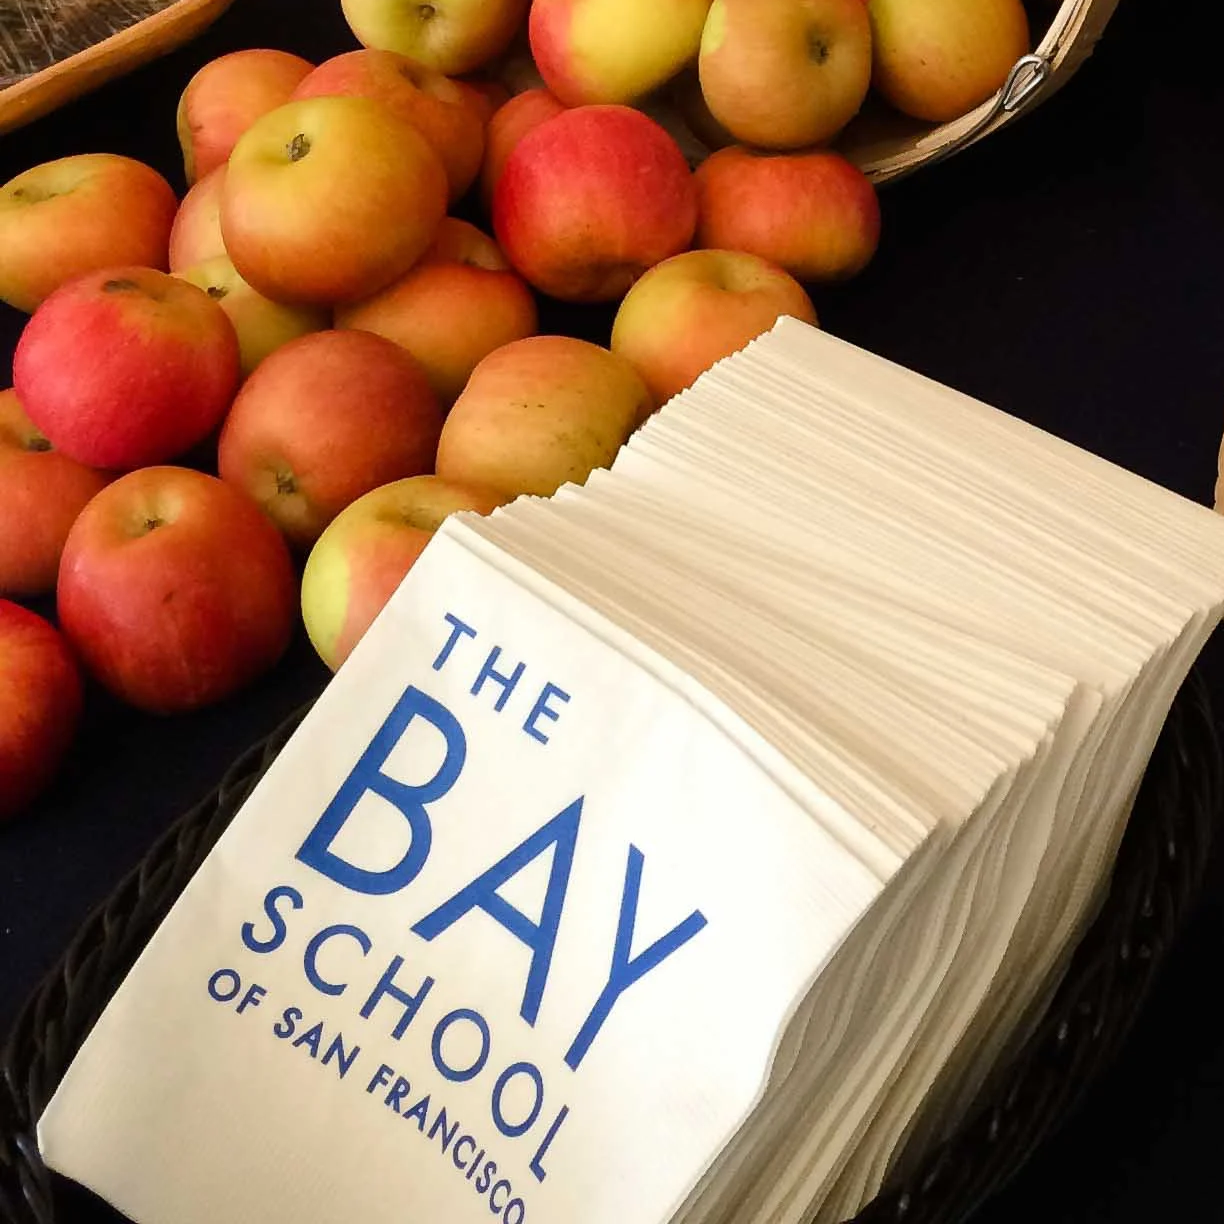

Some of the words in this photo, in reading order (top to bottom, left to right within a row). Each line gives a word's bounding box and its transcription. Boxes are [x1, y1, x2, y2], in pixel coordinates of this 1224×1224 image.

[430, 612, 573, 745] THE
[294, 684, 709, 1071] BAY
[207, 967, 266, 1016] OF
[273, 1006, 362, 1079] SAN
[365, 1063, 526, 1224] FRANCISCO
[241, 884, 570, 1183] SCHOOL
